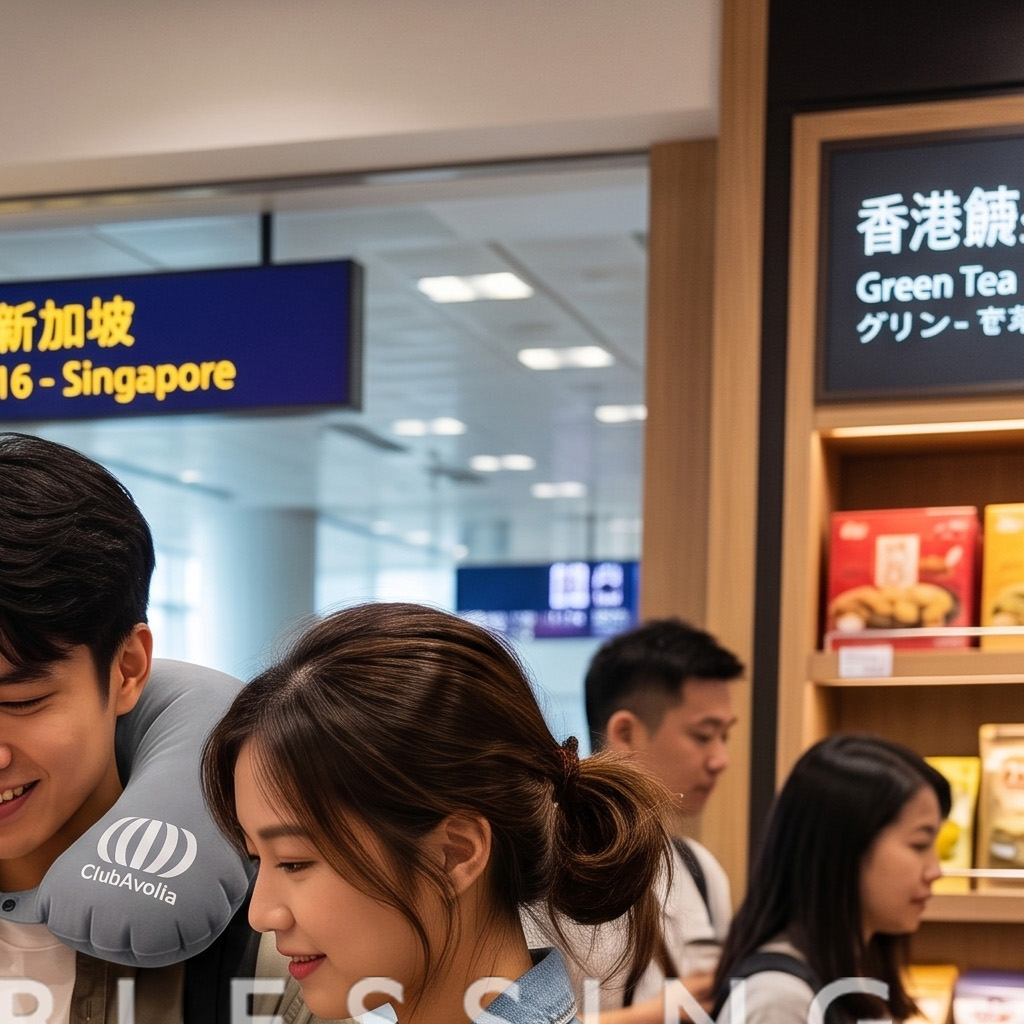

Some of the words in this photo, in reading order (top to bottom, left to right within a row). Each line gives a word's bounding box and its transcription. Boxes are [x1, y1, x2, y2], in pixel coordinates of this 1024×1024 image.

[856, 271, 954, 304] Green
[959, 264, 1018, 297] Tea
[62, 359, 237, 404] Singapore
